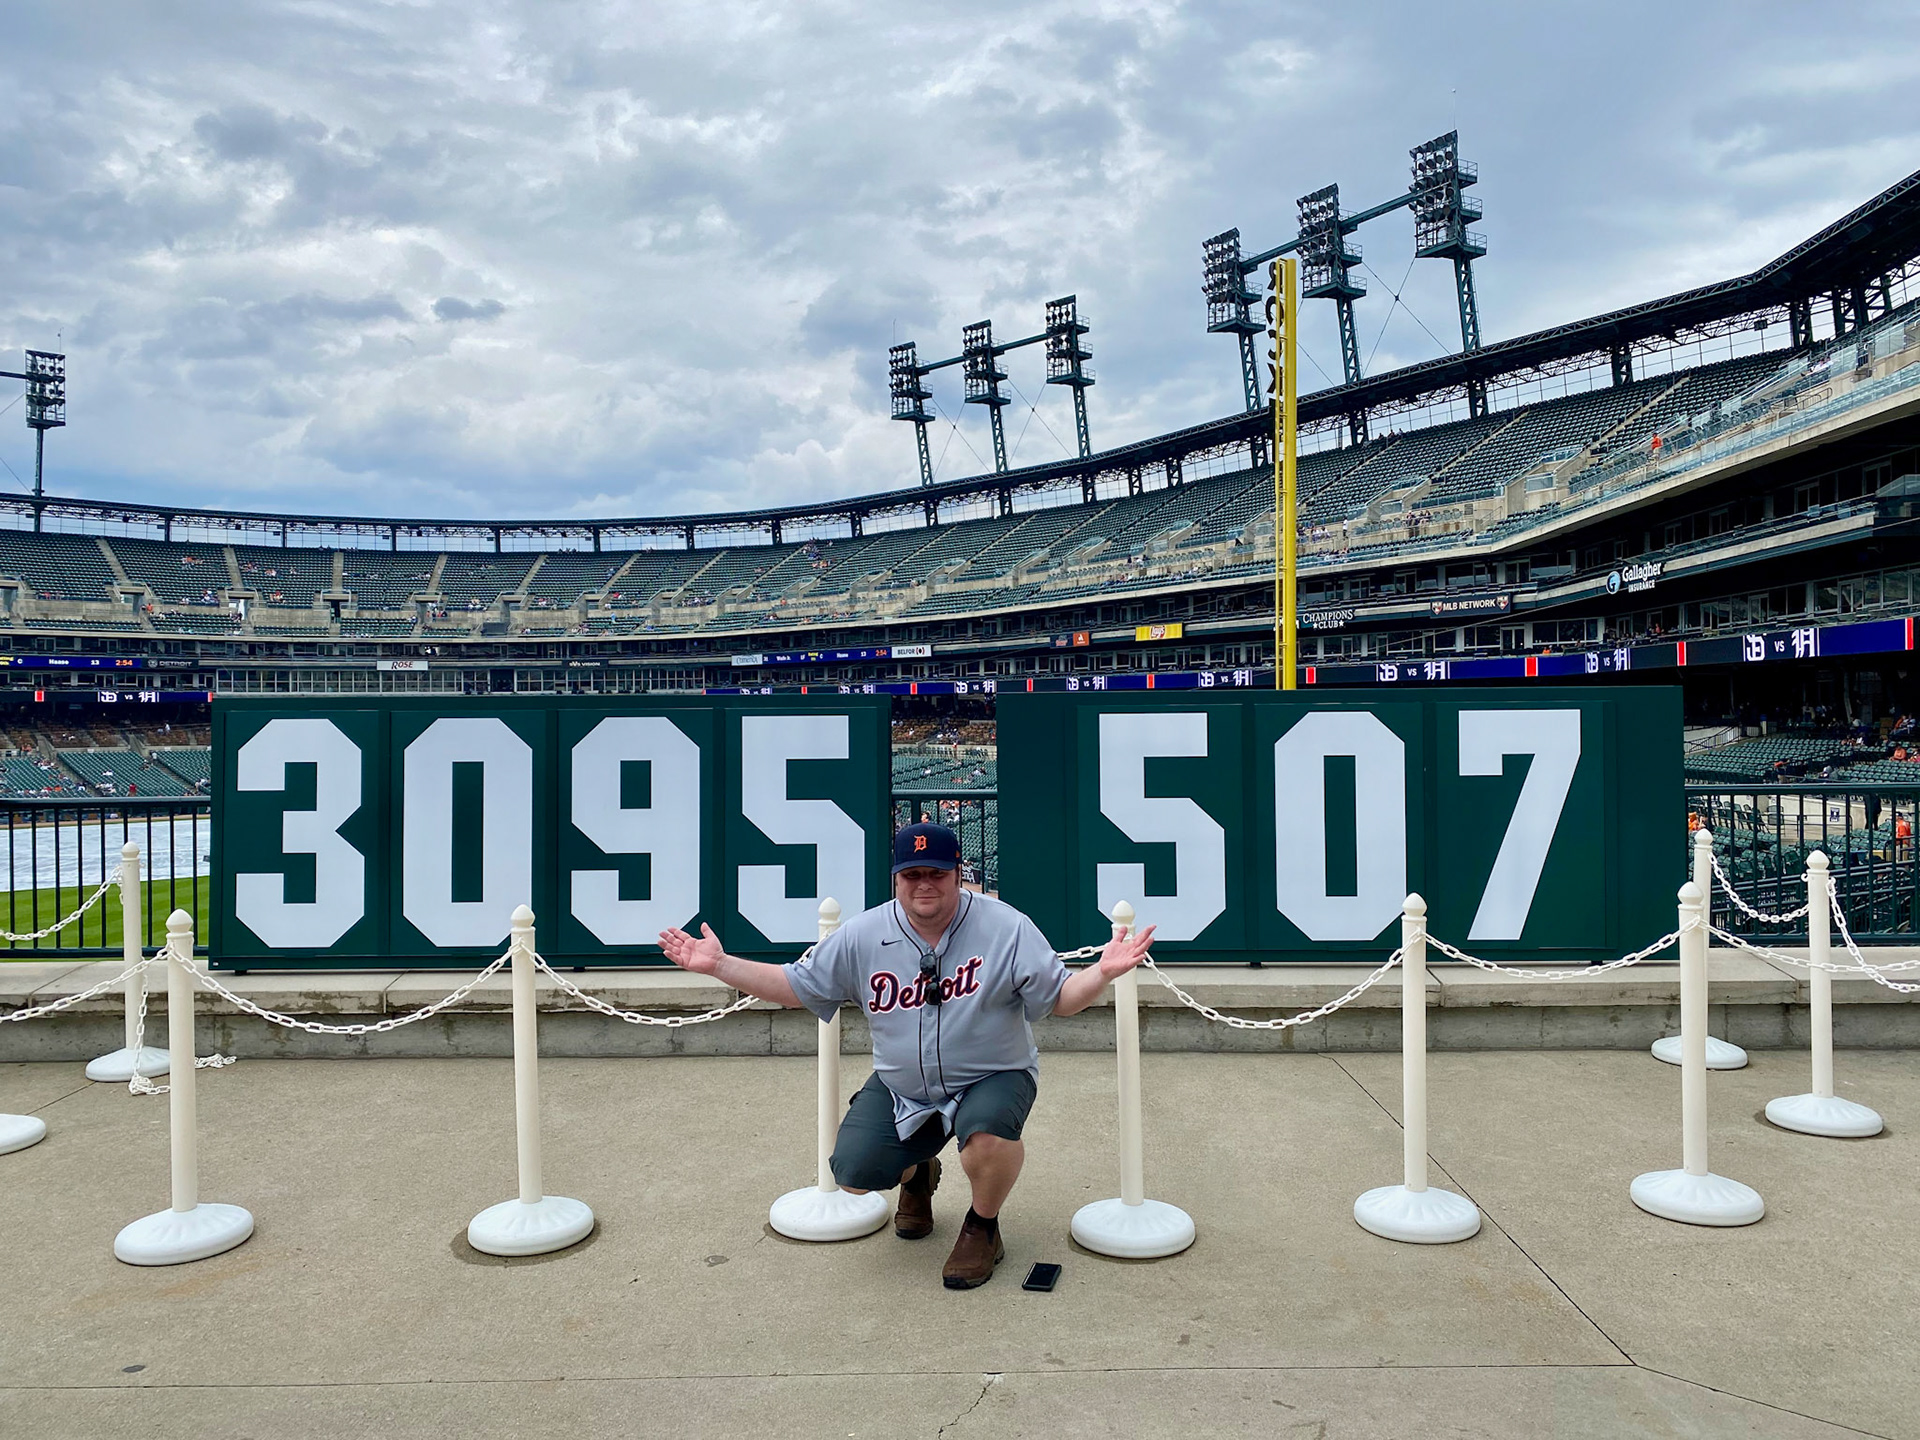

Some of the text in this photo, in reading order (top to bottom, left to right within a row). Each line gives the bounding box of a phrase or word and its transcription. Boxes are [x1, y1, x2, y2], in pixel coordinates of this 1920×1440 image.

[1622, 561, 1662, 582] Gallagher
[1628, 579, 1655, 593] INSURANCE
[1443, 598, 1496, 611] MLB NETWORK
[1302, 609, 1353, 623] CHAMPIONS
[1318, 620, 1338, 629] CLUB
[875, 649, 887, 657] 2:54
[391, 661, 413, 669] ROSE
[235, 716, 866, 948] 3095
[1097, 709, 1581, 941] 507
[914, 835, 927, 853] D
[868, 955, 984, 1014] Detoit
